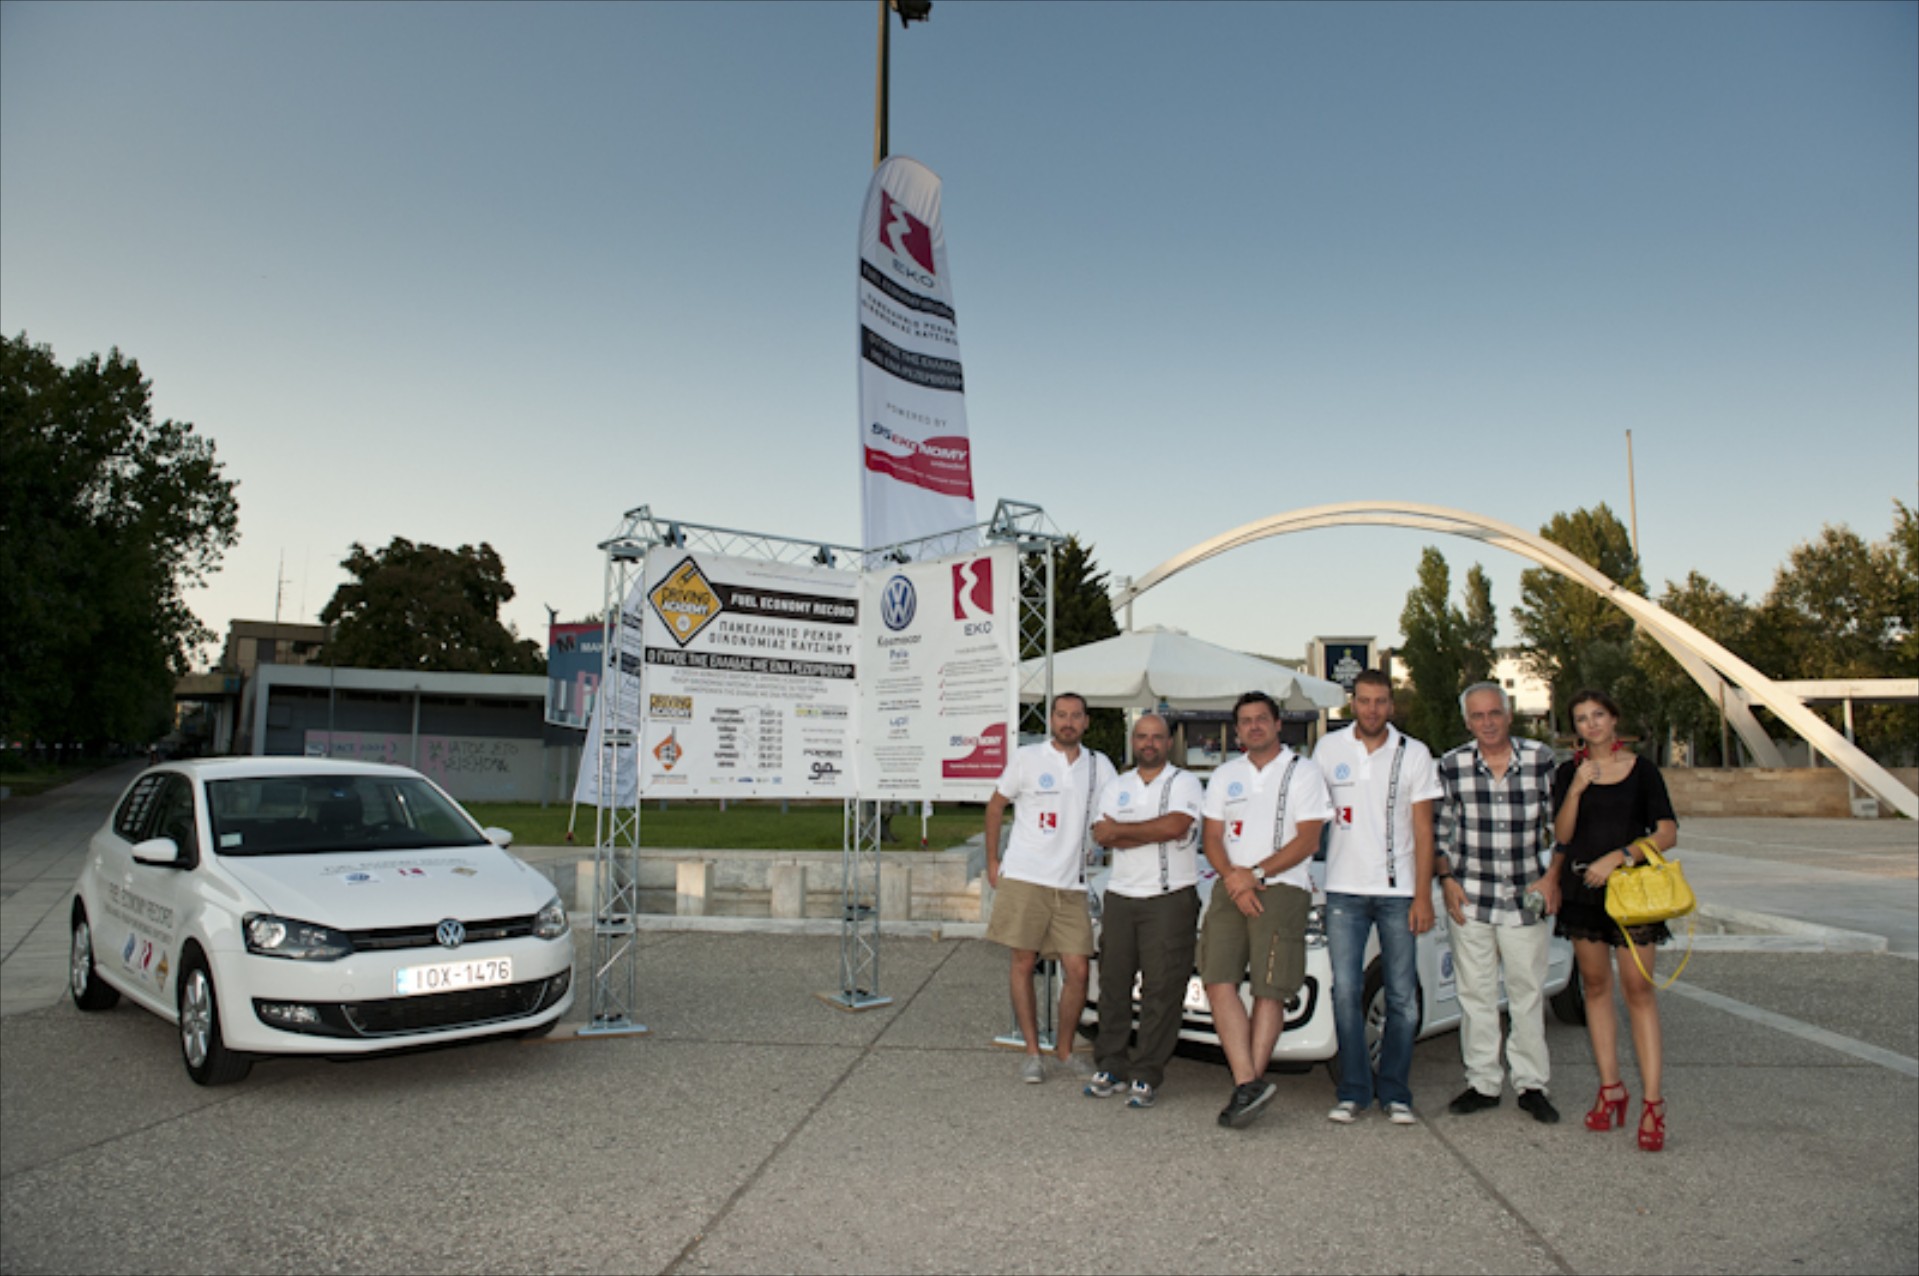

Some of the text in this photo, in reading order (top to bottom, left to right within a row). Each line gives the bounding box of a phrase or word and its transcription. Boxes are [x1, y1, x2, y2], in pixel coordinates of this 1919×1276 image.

[892, 258, 935, 288] EKO
[661, 599, 709, 616] ACADEMY
[730, 592, 856, 618] FUEL ECONOMY RECORD
[802, 628, 843, 642] ΡΕΚΟΡ
[964, 620, 993, 636] EKO
[708, 632, 852, 655] ΟΙΚΟΝΟΜΙΑΣ ΚΑΥΣΙΜΟΥ
[416, 961, 510, 988] IOX-1476
